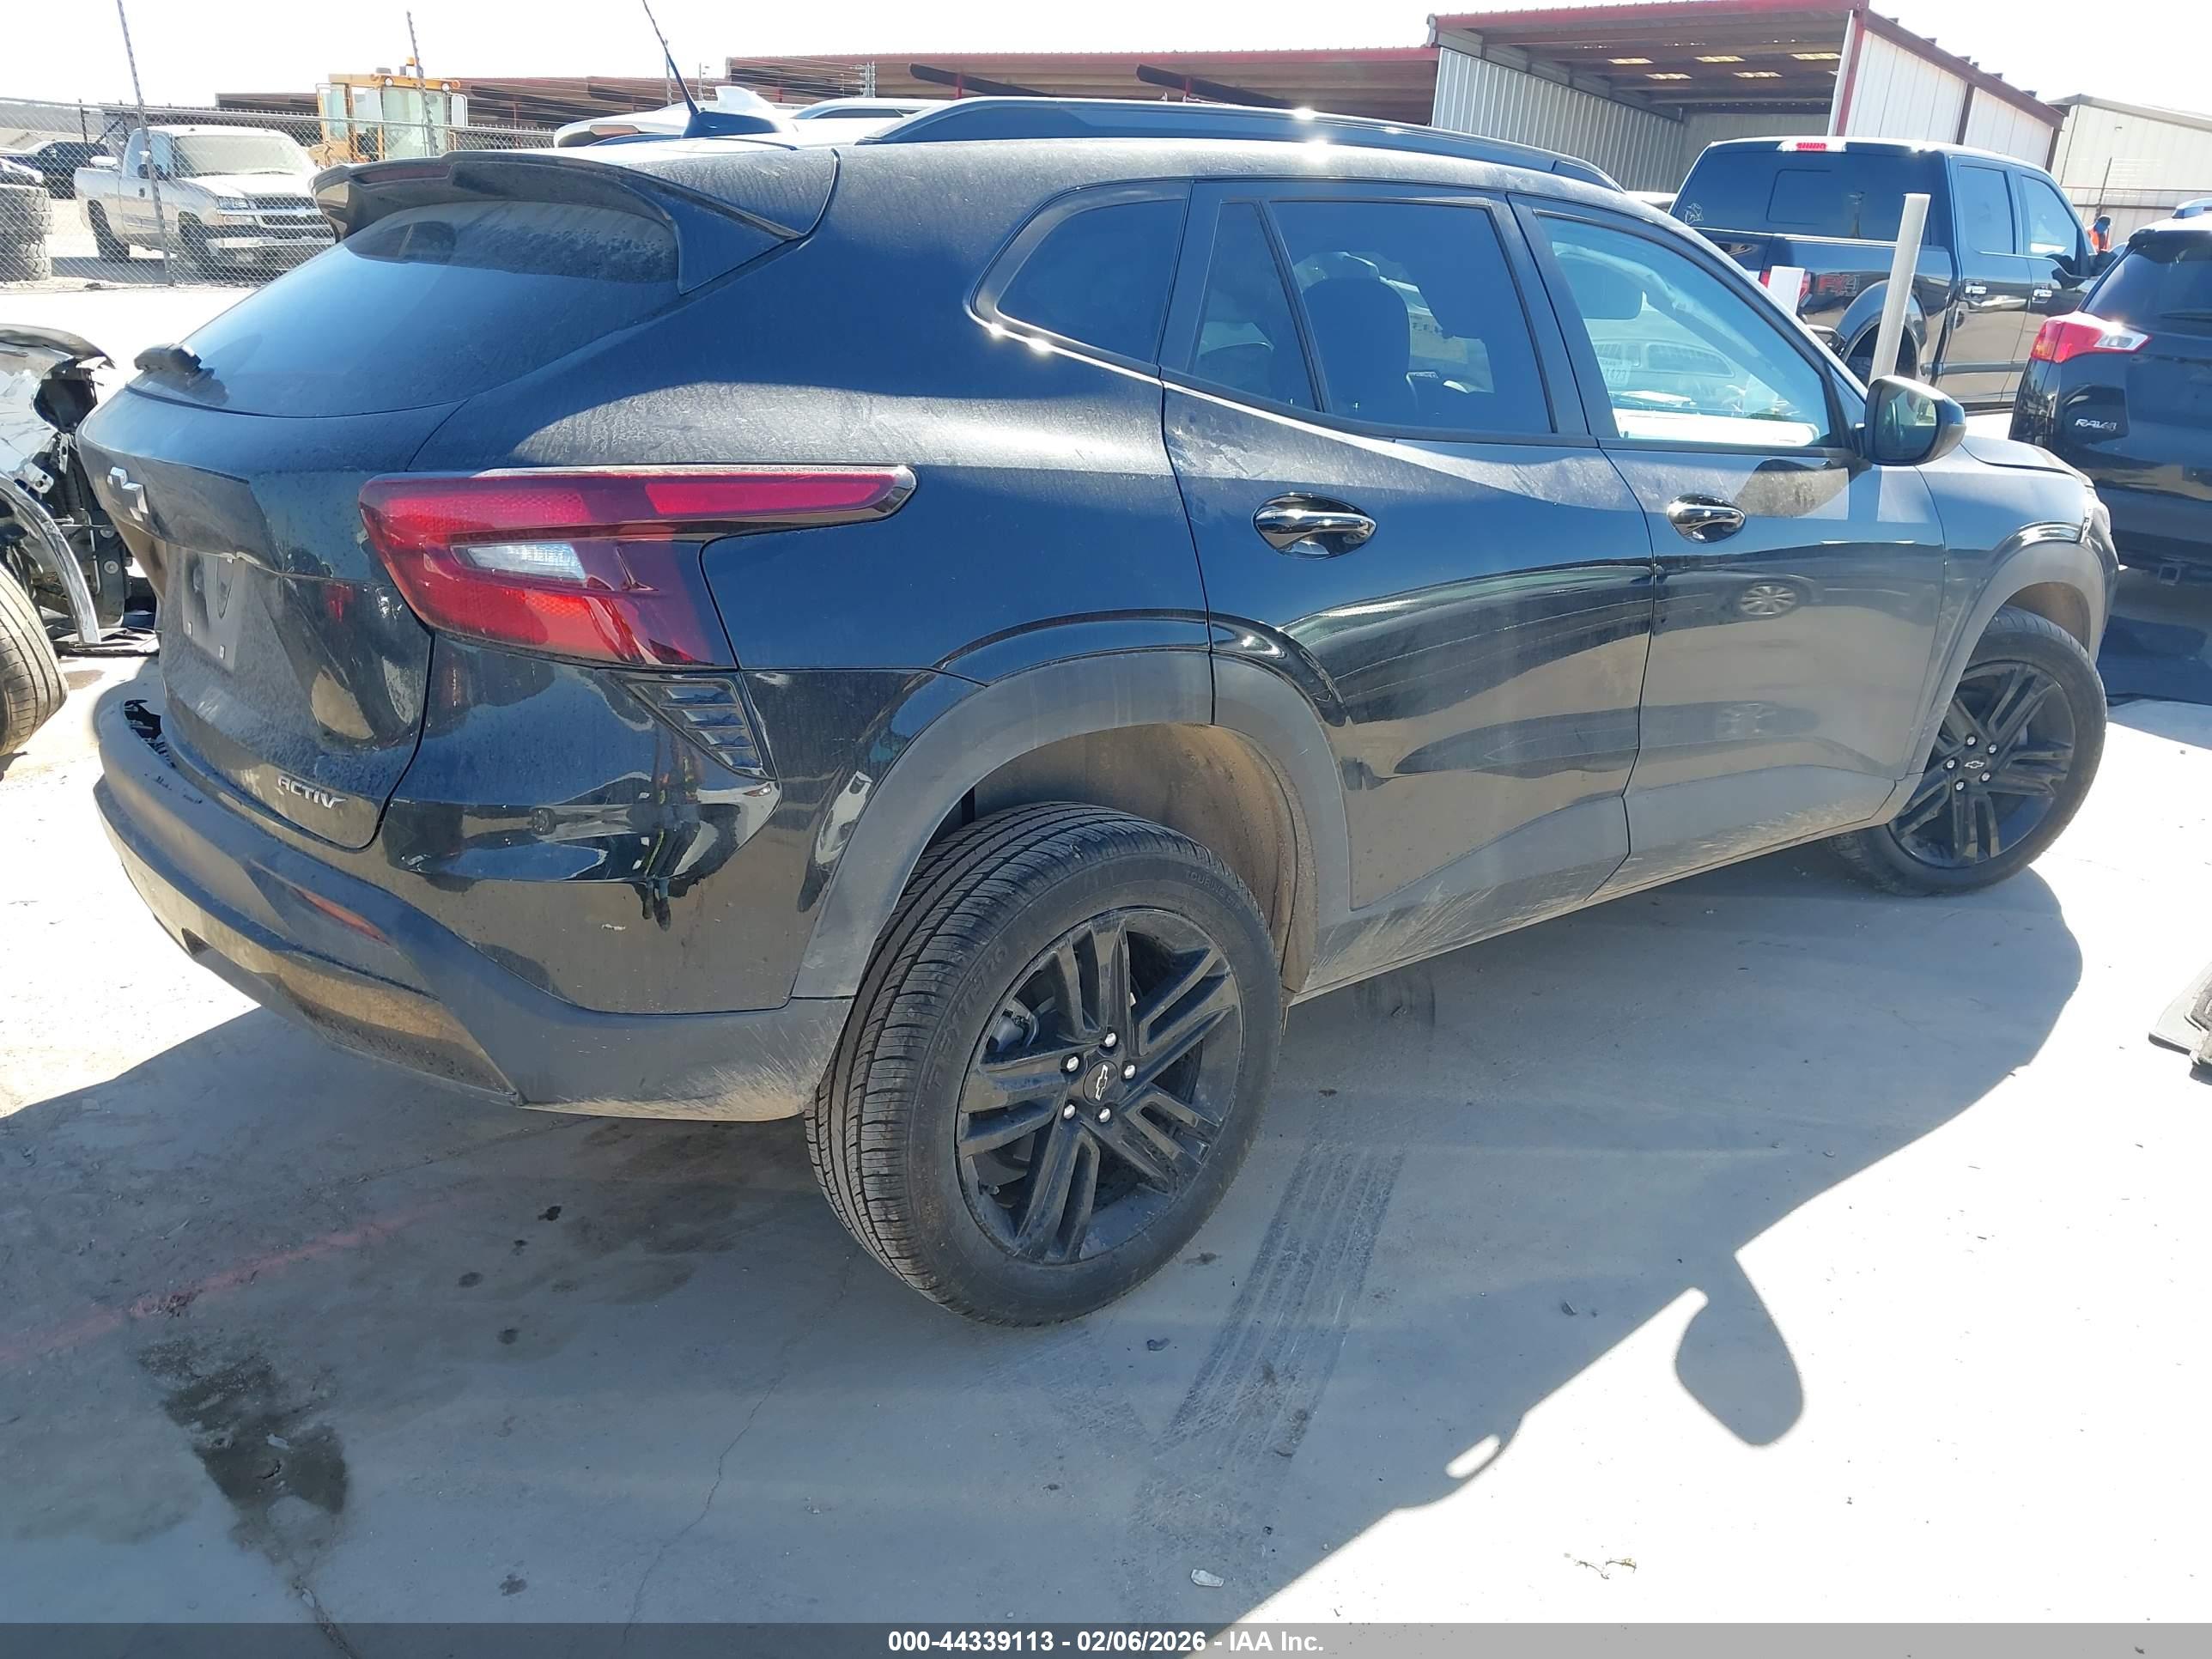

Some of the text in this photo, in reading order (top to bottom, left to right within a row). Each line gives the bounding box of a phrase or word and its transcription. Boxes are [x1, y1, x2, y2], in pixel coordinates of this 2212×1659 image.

[1817, 274, 1860, 296] FX4
[2075, 418, 2117, 431] RAV4
[277, 775, 348, 809] ACTIV
